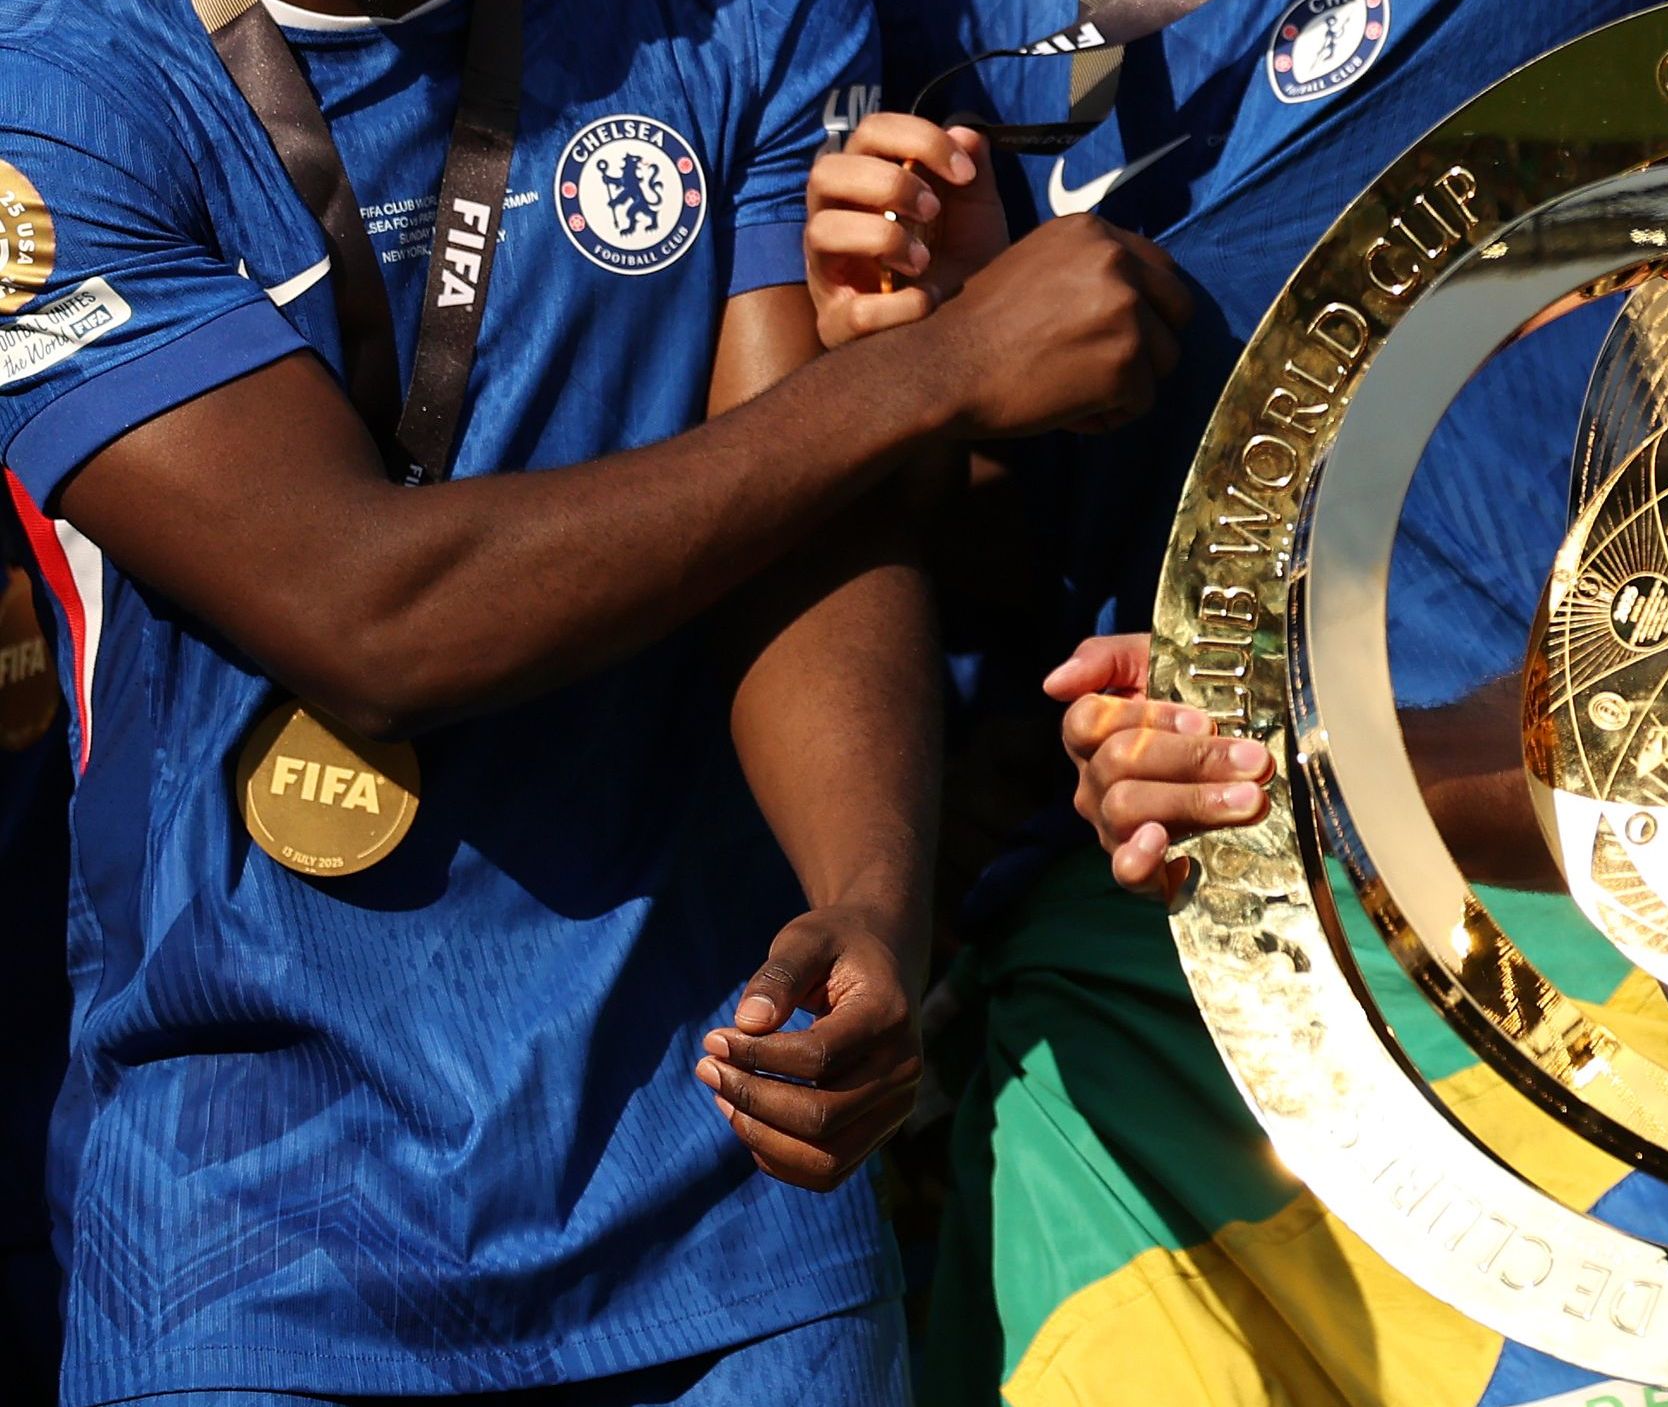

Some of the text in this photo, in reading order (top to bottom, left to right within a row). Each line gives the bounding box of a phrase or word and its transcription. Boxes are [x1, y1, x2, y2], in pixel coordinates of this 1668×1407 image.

[571, 120, 664, 163] CHELSEA
[360, 202, 384, 220] FIFA
[384, 198, 415, 216] CLUB
[394, 216, 409, 229] FC
[16, 222, 35, 266] USA
[437, 197, 492, 310] FIFA
[593, 225, 689, 267] FOOTBALL CLUB
[48, 291, 98, 326] UNITES
[4, 354, 28, 379] the
[72, 308, 112, 338] FIFA
[1209, 301, 1371, 553] WORLD
[1363, 164, 1480, 296] CUP
[270, 755, 385, 815] FIFA
[282, 846, 344, 869] 13 JULY 2025
[1562, 1262, 1665, 1338] DE
